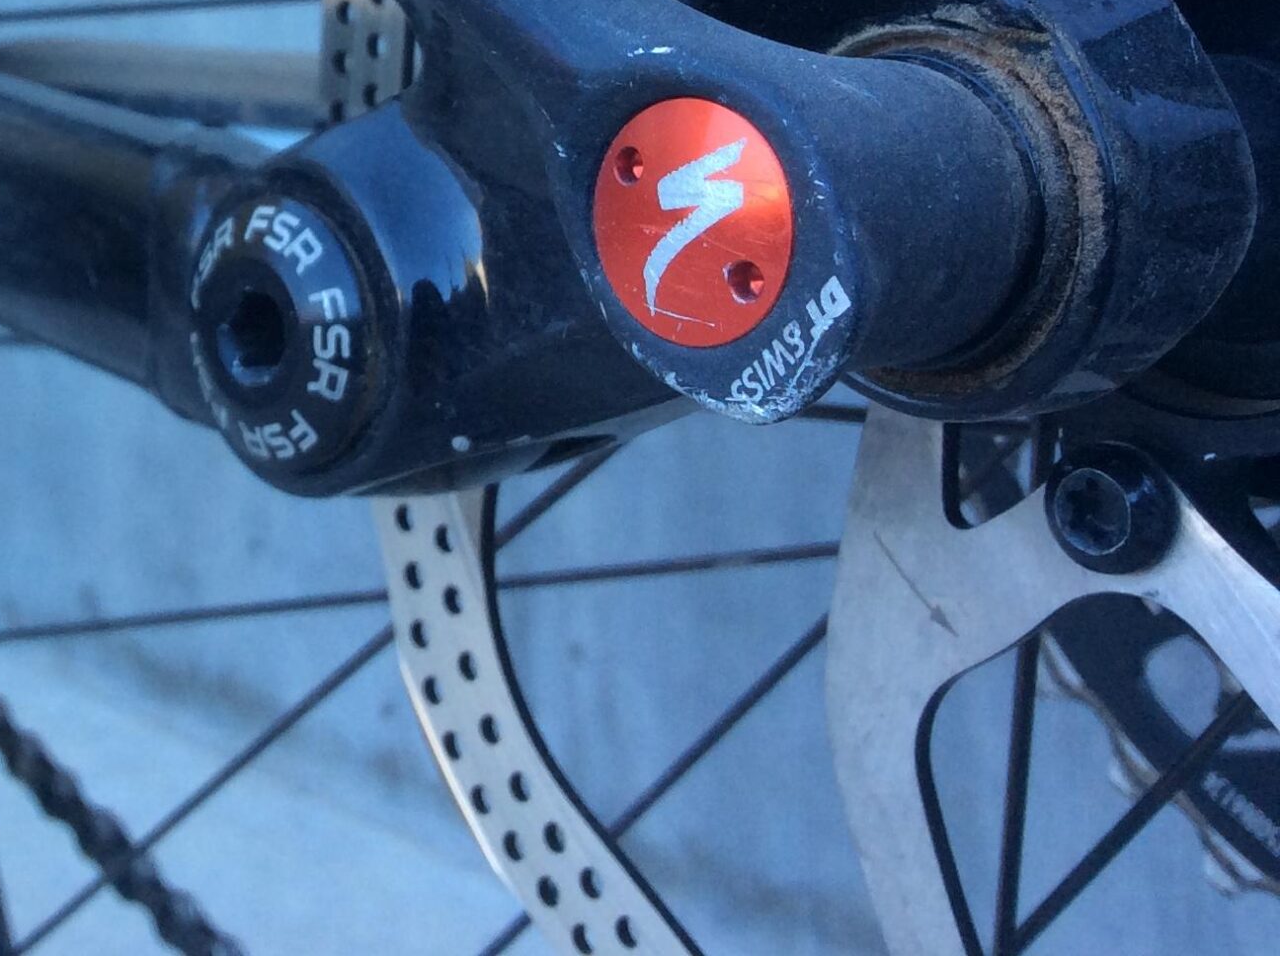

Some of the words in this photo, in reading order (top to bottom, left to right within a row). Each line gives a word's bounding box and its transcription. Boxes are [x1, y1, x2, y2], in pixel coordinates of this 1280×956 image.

[244, 205, 323, 276] FSR
[306, 287, 352, 402] FSR
[730, 319, 806, 405] SWISS
[236, 408, 320, 460] FSR
